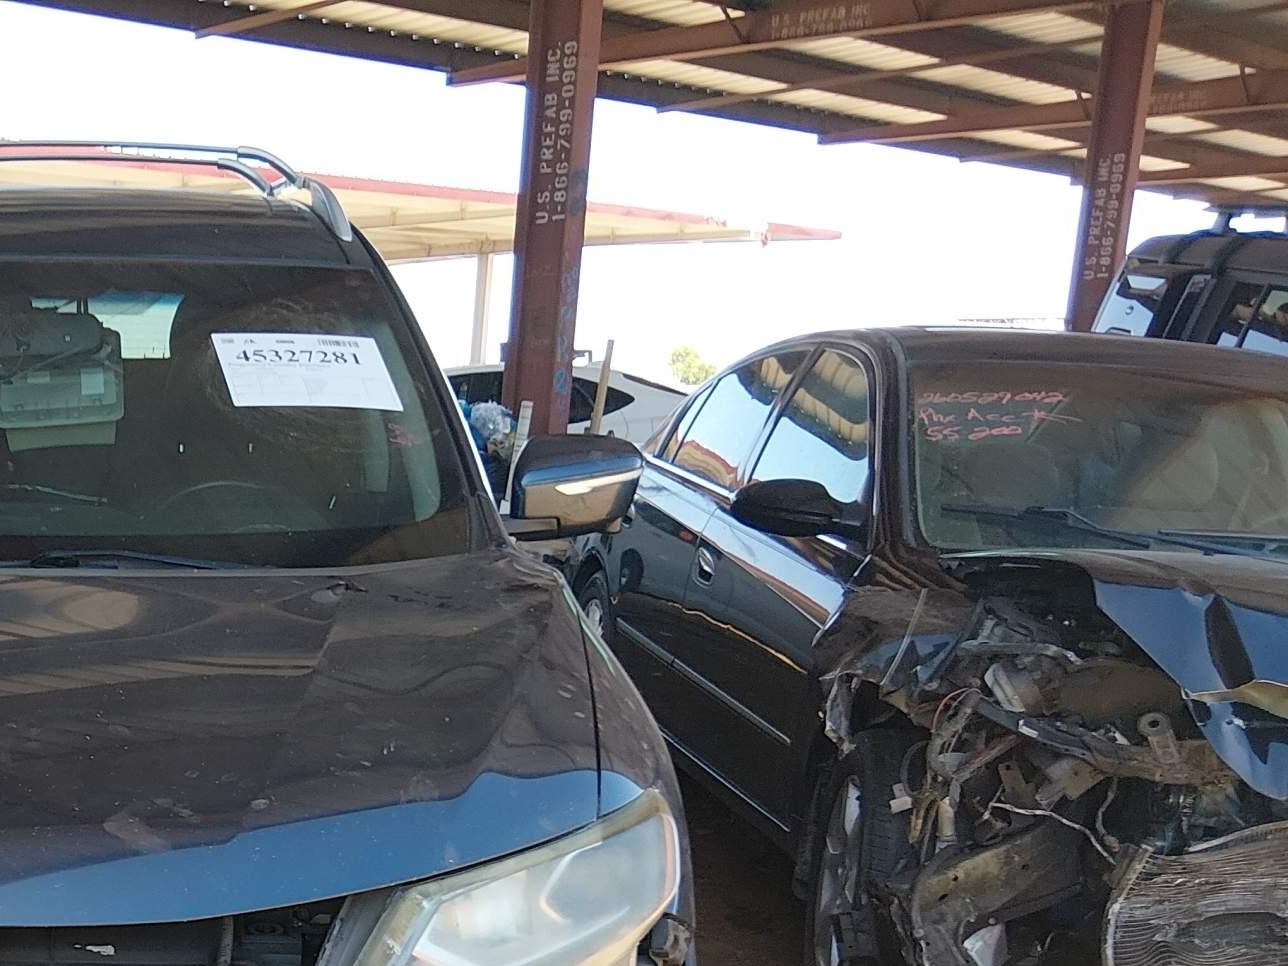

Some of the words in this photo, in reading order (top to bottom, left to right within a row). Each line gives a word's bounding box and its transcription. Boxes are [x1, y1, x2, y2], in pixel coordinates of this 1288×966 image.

[545, 41, 562, 83] INC.
[539, 93, 558, 174] PREFAB
[551, 40, 578, 222] 1-866-799-0969
[536, 184, 553, 225] U.S.
[1088, 187, 1107, 246] PREFAB
[235, 349, 362, 366] 45327281
